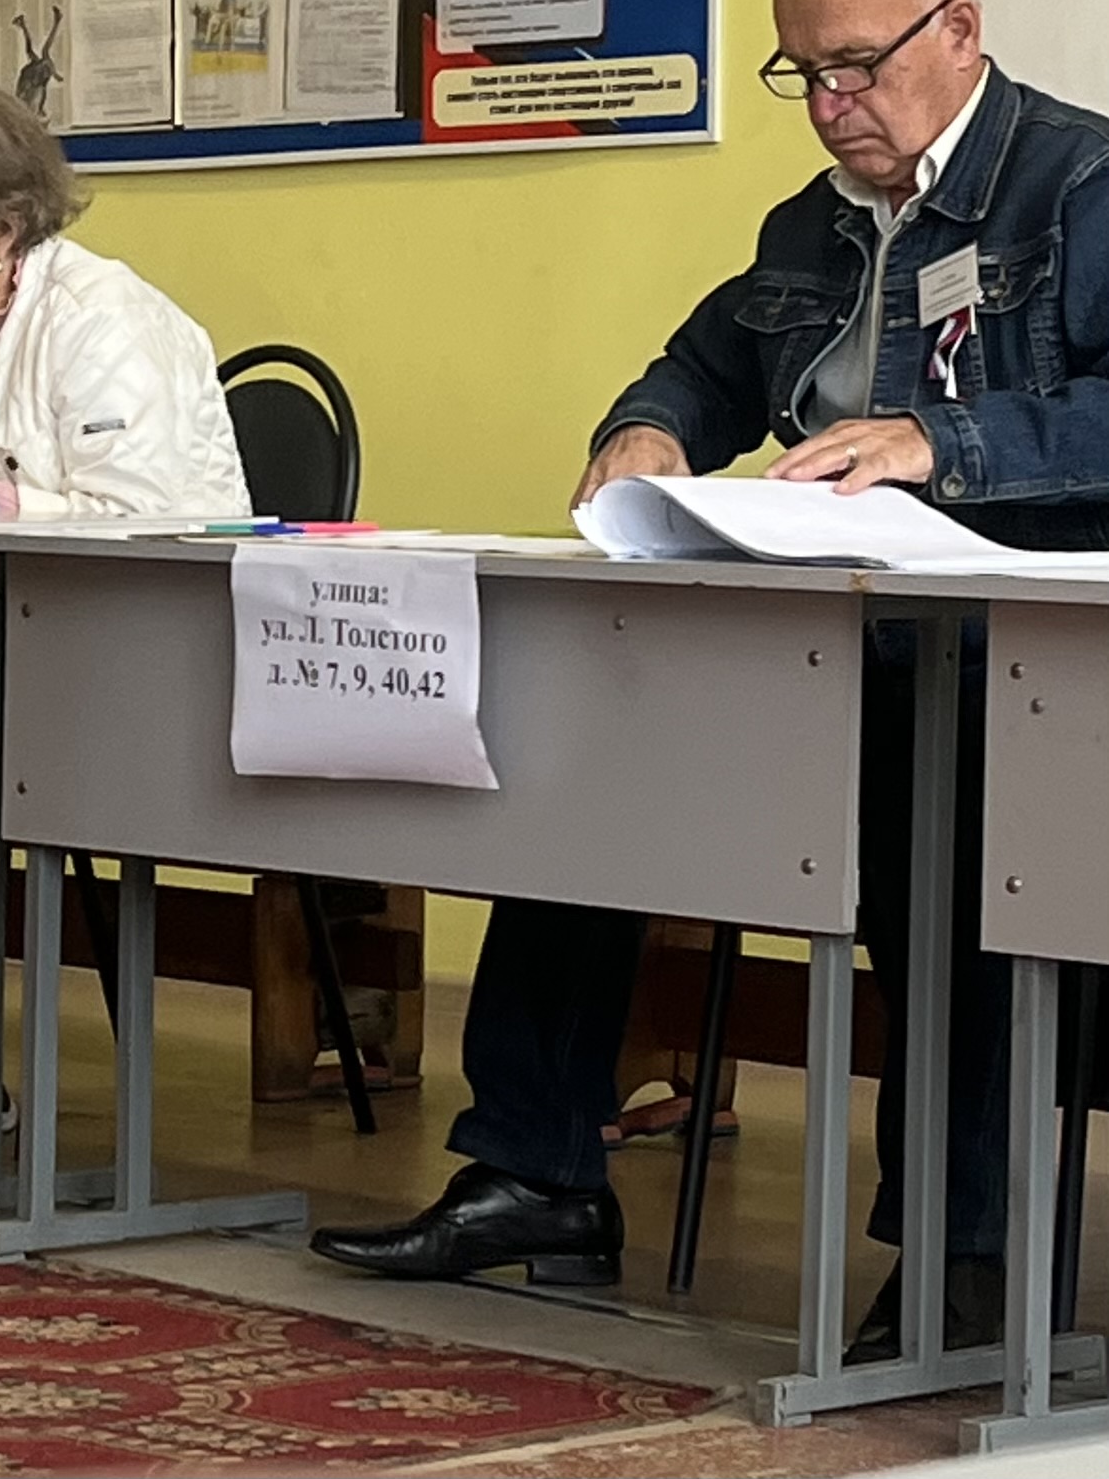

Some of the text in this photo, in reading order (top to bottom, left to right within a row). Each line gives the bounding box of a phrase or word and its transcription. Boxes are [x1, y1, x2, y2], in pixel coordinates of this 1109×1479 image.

[310, 580, 388, 608] улица:
[260, 615, 447, 654] ул. Л. Толстого
[267, 663, 287, 686] д.
[293, 658, 319, 688] №
[327, 662, 347, 695] 7,
[354, 664, 375, 699] 9,
